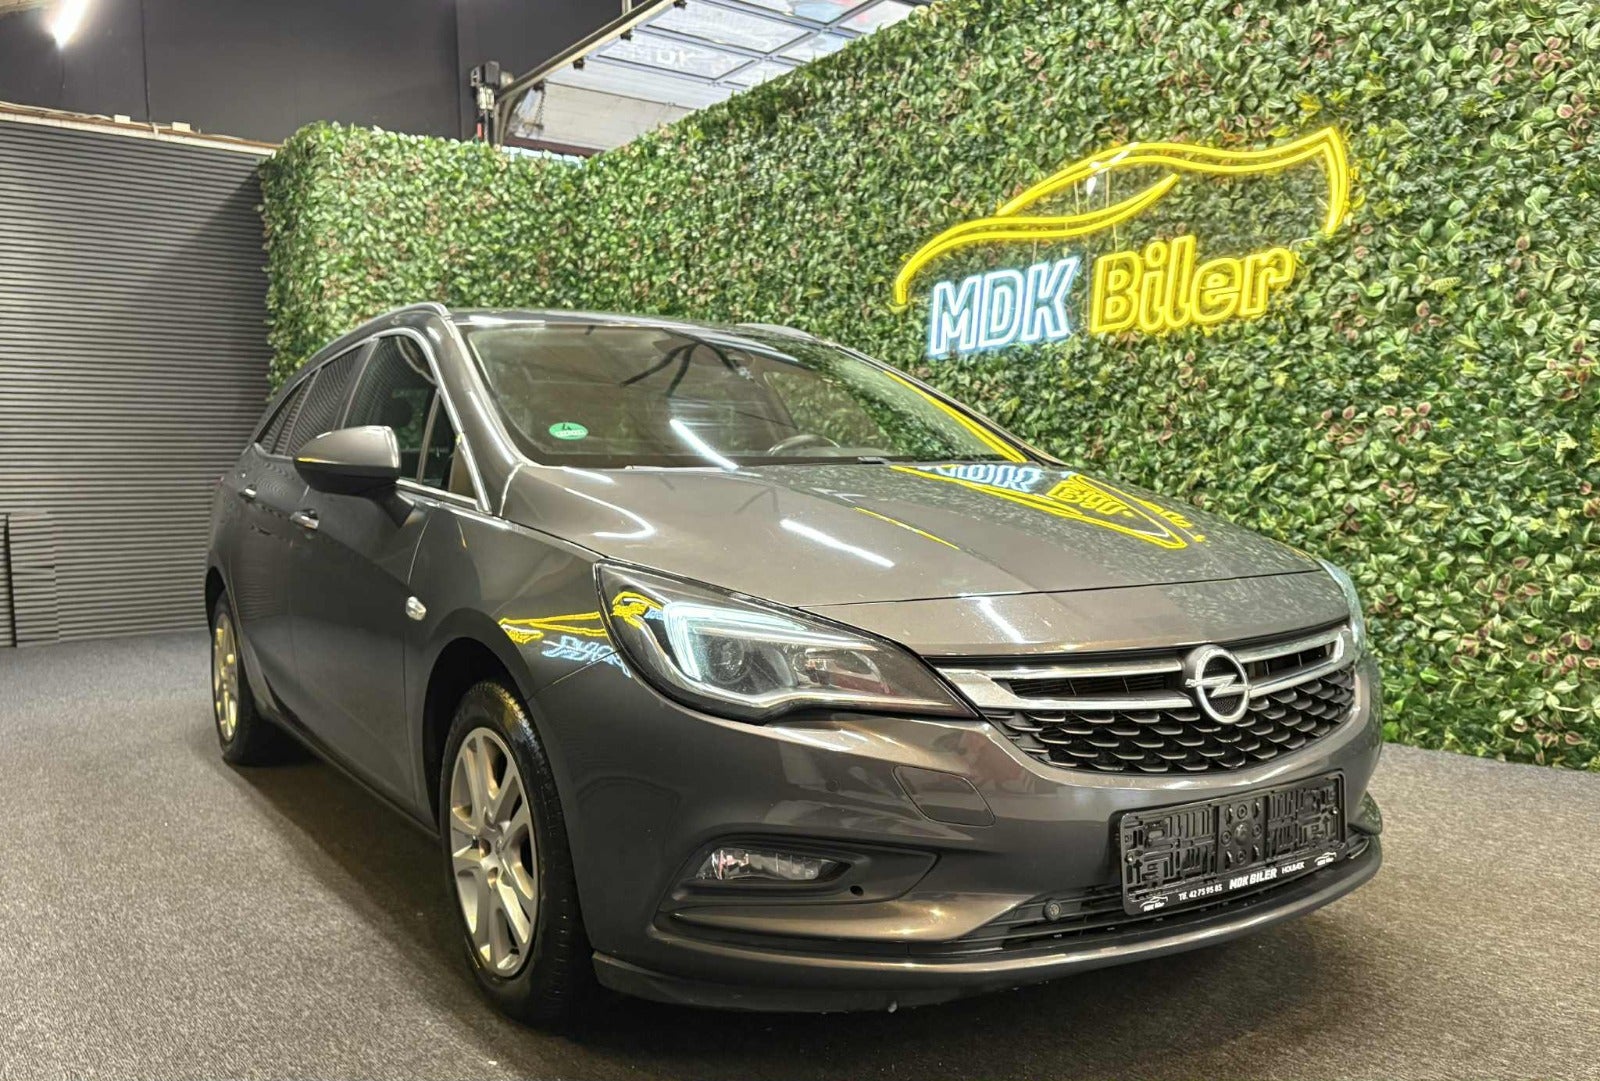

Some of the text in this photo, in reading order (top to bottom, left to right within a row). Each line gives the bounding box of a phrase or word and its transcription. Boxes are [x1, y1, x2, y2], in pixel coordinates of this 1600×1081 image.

[929, 235, 1296, 356] MDK Biler
[1229, 868, 1277, 890] MDK BILER
[1189, 890, 1198, 898] 42
[1198, 888, 1206, 897] 75
[1206, 886, 1214, 895] 95
